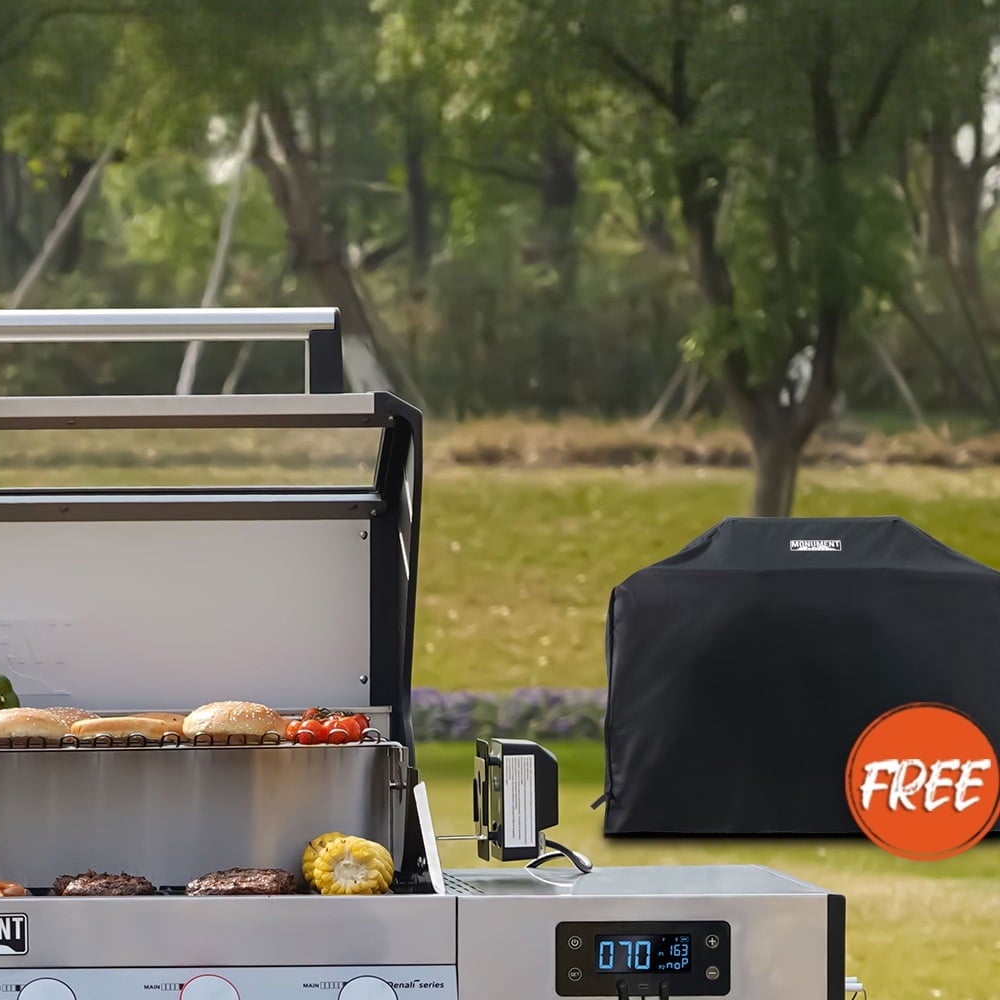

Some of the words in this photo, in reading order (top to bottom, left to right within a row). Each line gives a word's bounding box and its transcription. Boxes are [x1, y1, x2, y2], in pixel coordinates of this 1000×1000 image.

[791, 540, 840, 548] MONUMENT
[598, 940, 651, 970] 070
[669, 944, 689, 957] 163
[419, 980, 444, 988] series
